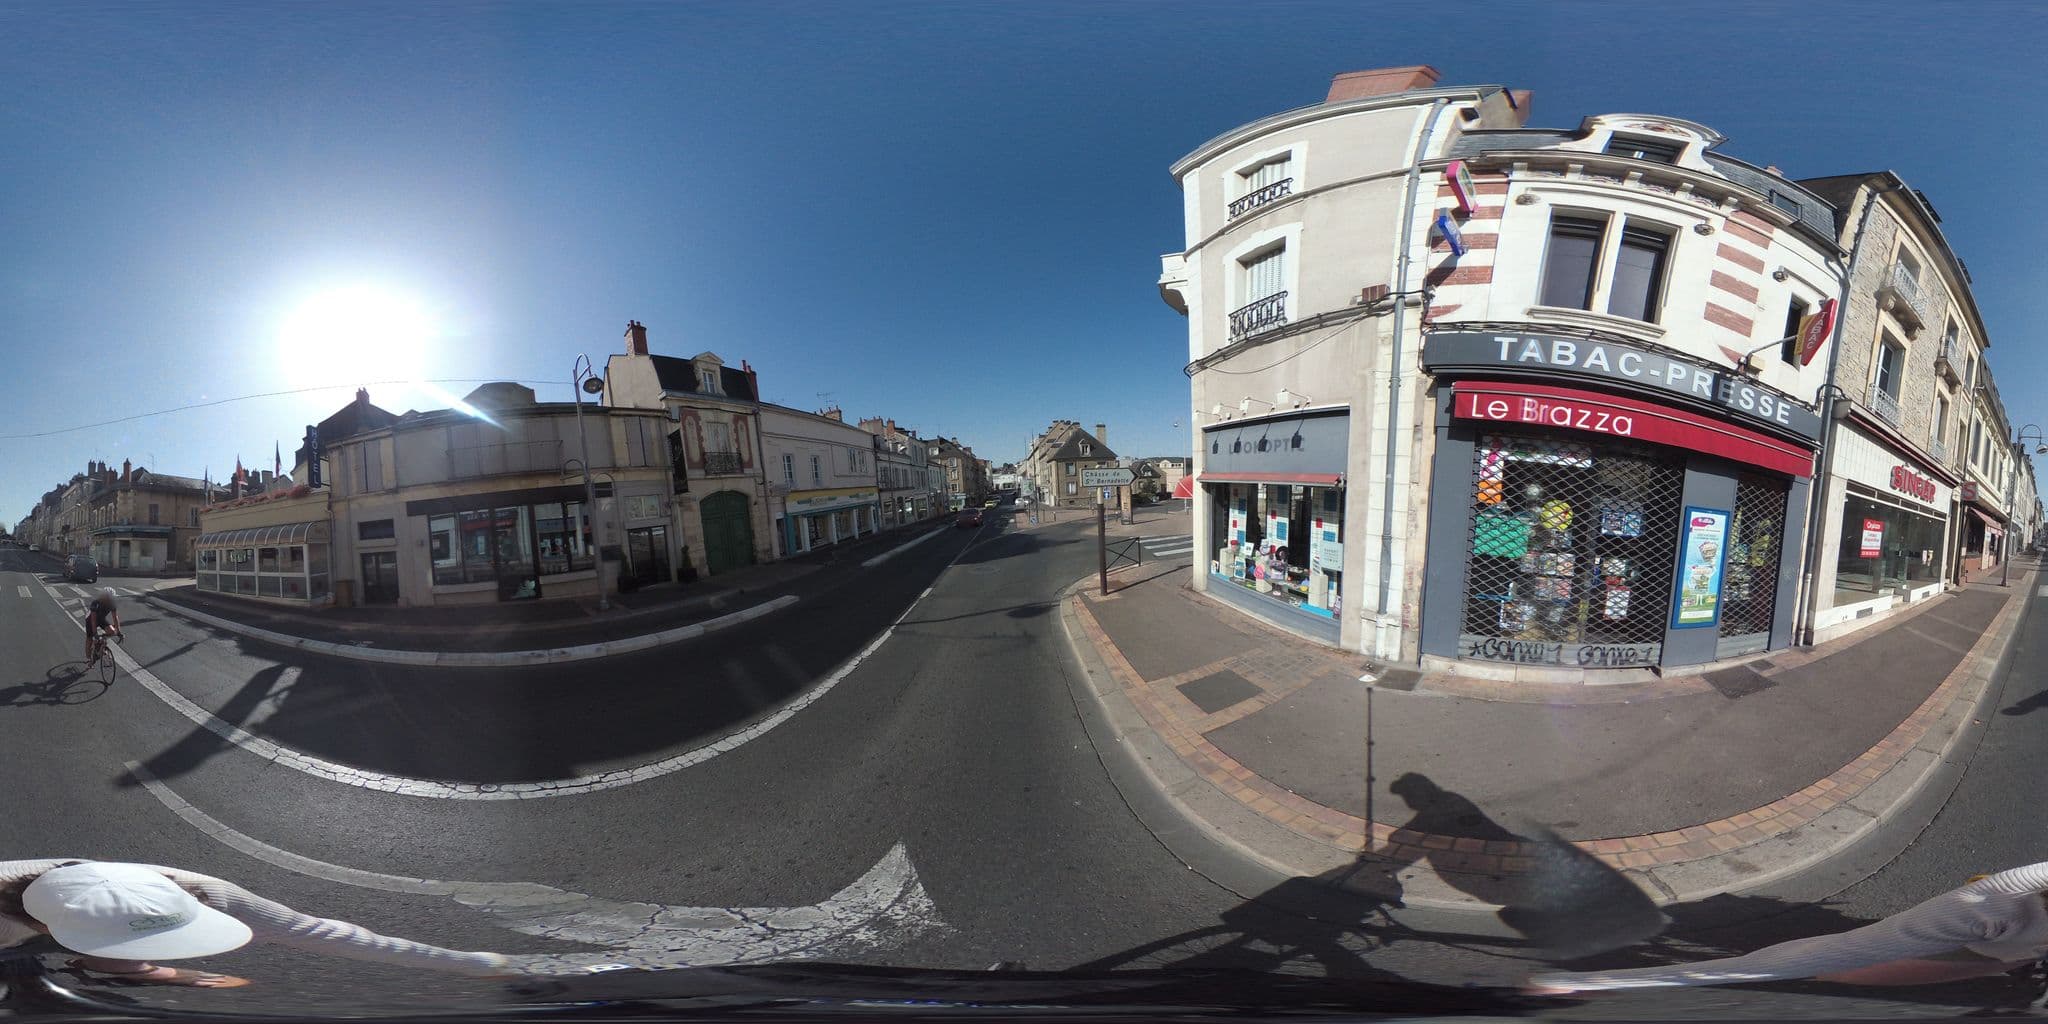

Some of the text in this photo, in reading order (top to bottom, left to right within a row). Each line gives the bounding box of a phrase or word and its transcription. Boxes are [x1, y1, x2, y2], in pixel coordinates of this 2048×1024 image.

[1806, 311, 1828, 350] TABAC
[1493, 336, 1791, 425] TABAC-PRESSE
[1472, 394, 1633, 436] Le Brazza
[1891, 465, 1937, 503] SINGER
